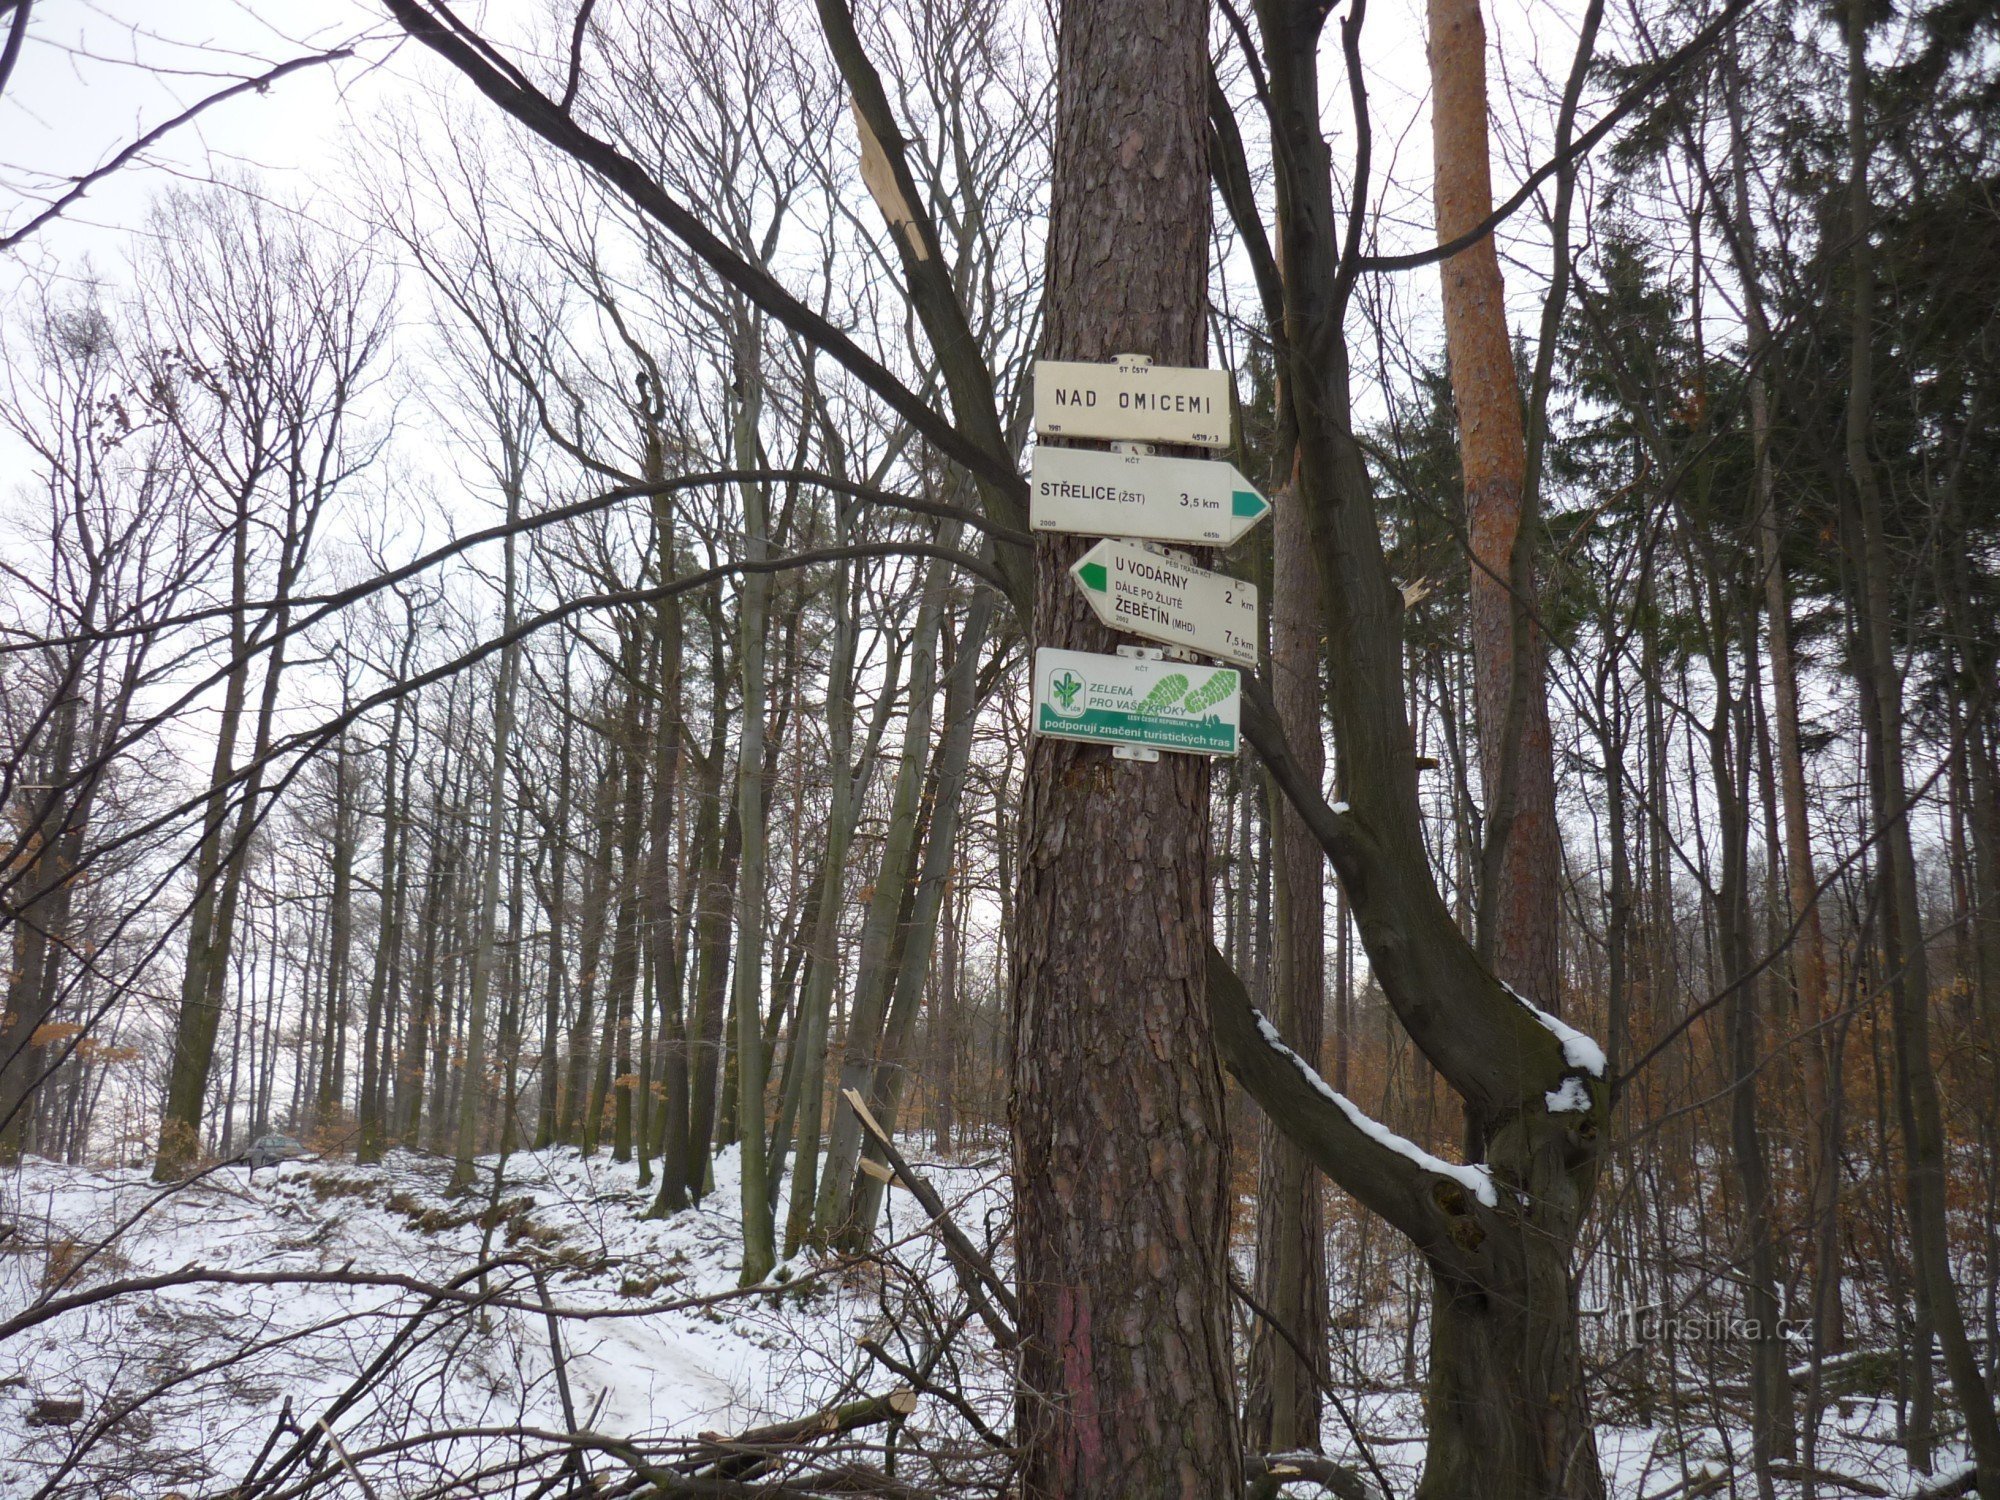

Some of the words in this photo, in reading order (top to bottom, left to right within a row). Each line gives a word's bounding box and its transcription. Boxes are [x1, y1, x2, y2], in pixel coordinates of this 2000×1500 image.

[1119, 366, 1128, 374] ST
[1056, 389, 1096, 407] NAD
[1119, 392, 1210, 414] OMICEMI
[1125, 457, 1140, 465] KČT
[1040, 480, 1116, 500] STŘELICE
[1118, 492, 1146, 505] (ŽST)
[1180, 493, 1199, 509] 3,5
[1202, 499, 1220, 510] km
[1180, 563, 1199, 576] TRASA
[1115, 556, 1124, 571] U
[1128, 560, 1188, 590] VODÁRNY
[1225, 591, 1232, 604] 2
[1241, 599, 1254, 611] km
[1115, 580, 1138, 597] DÁLE
[1141, 587, 1153, 600] PO
[1156, 590, 1183, 609] ŽLUTÉ
[1115, 596, 1169, 625] ŽEBĚTÍN
[1172, 619, 1196, 635] (MHD)
[1225, 630, 1239, 646] 7,5
[1241, 637, 1254, 650] km
[1135, 665, 1149, 673] KČT
[1089, 682, 1133, 696] ZELENÁ
[1089, 697, 1113, 709] PRO
[1116, 697, 1143, 711] VAŠE
[1147, 704, 1187, 716] KROKY
[1127, 714, 1140, 722] LESY
[1045, 719, 1097, 734] podporují
[1099, 724, 1141, 738] značení
[1143, 728, 1206, 745] turistických
[1209, 736, 1230, 747] tras
